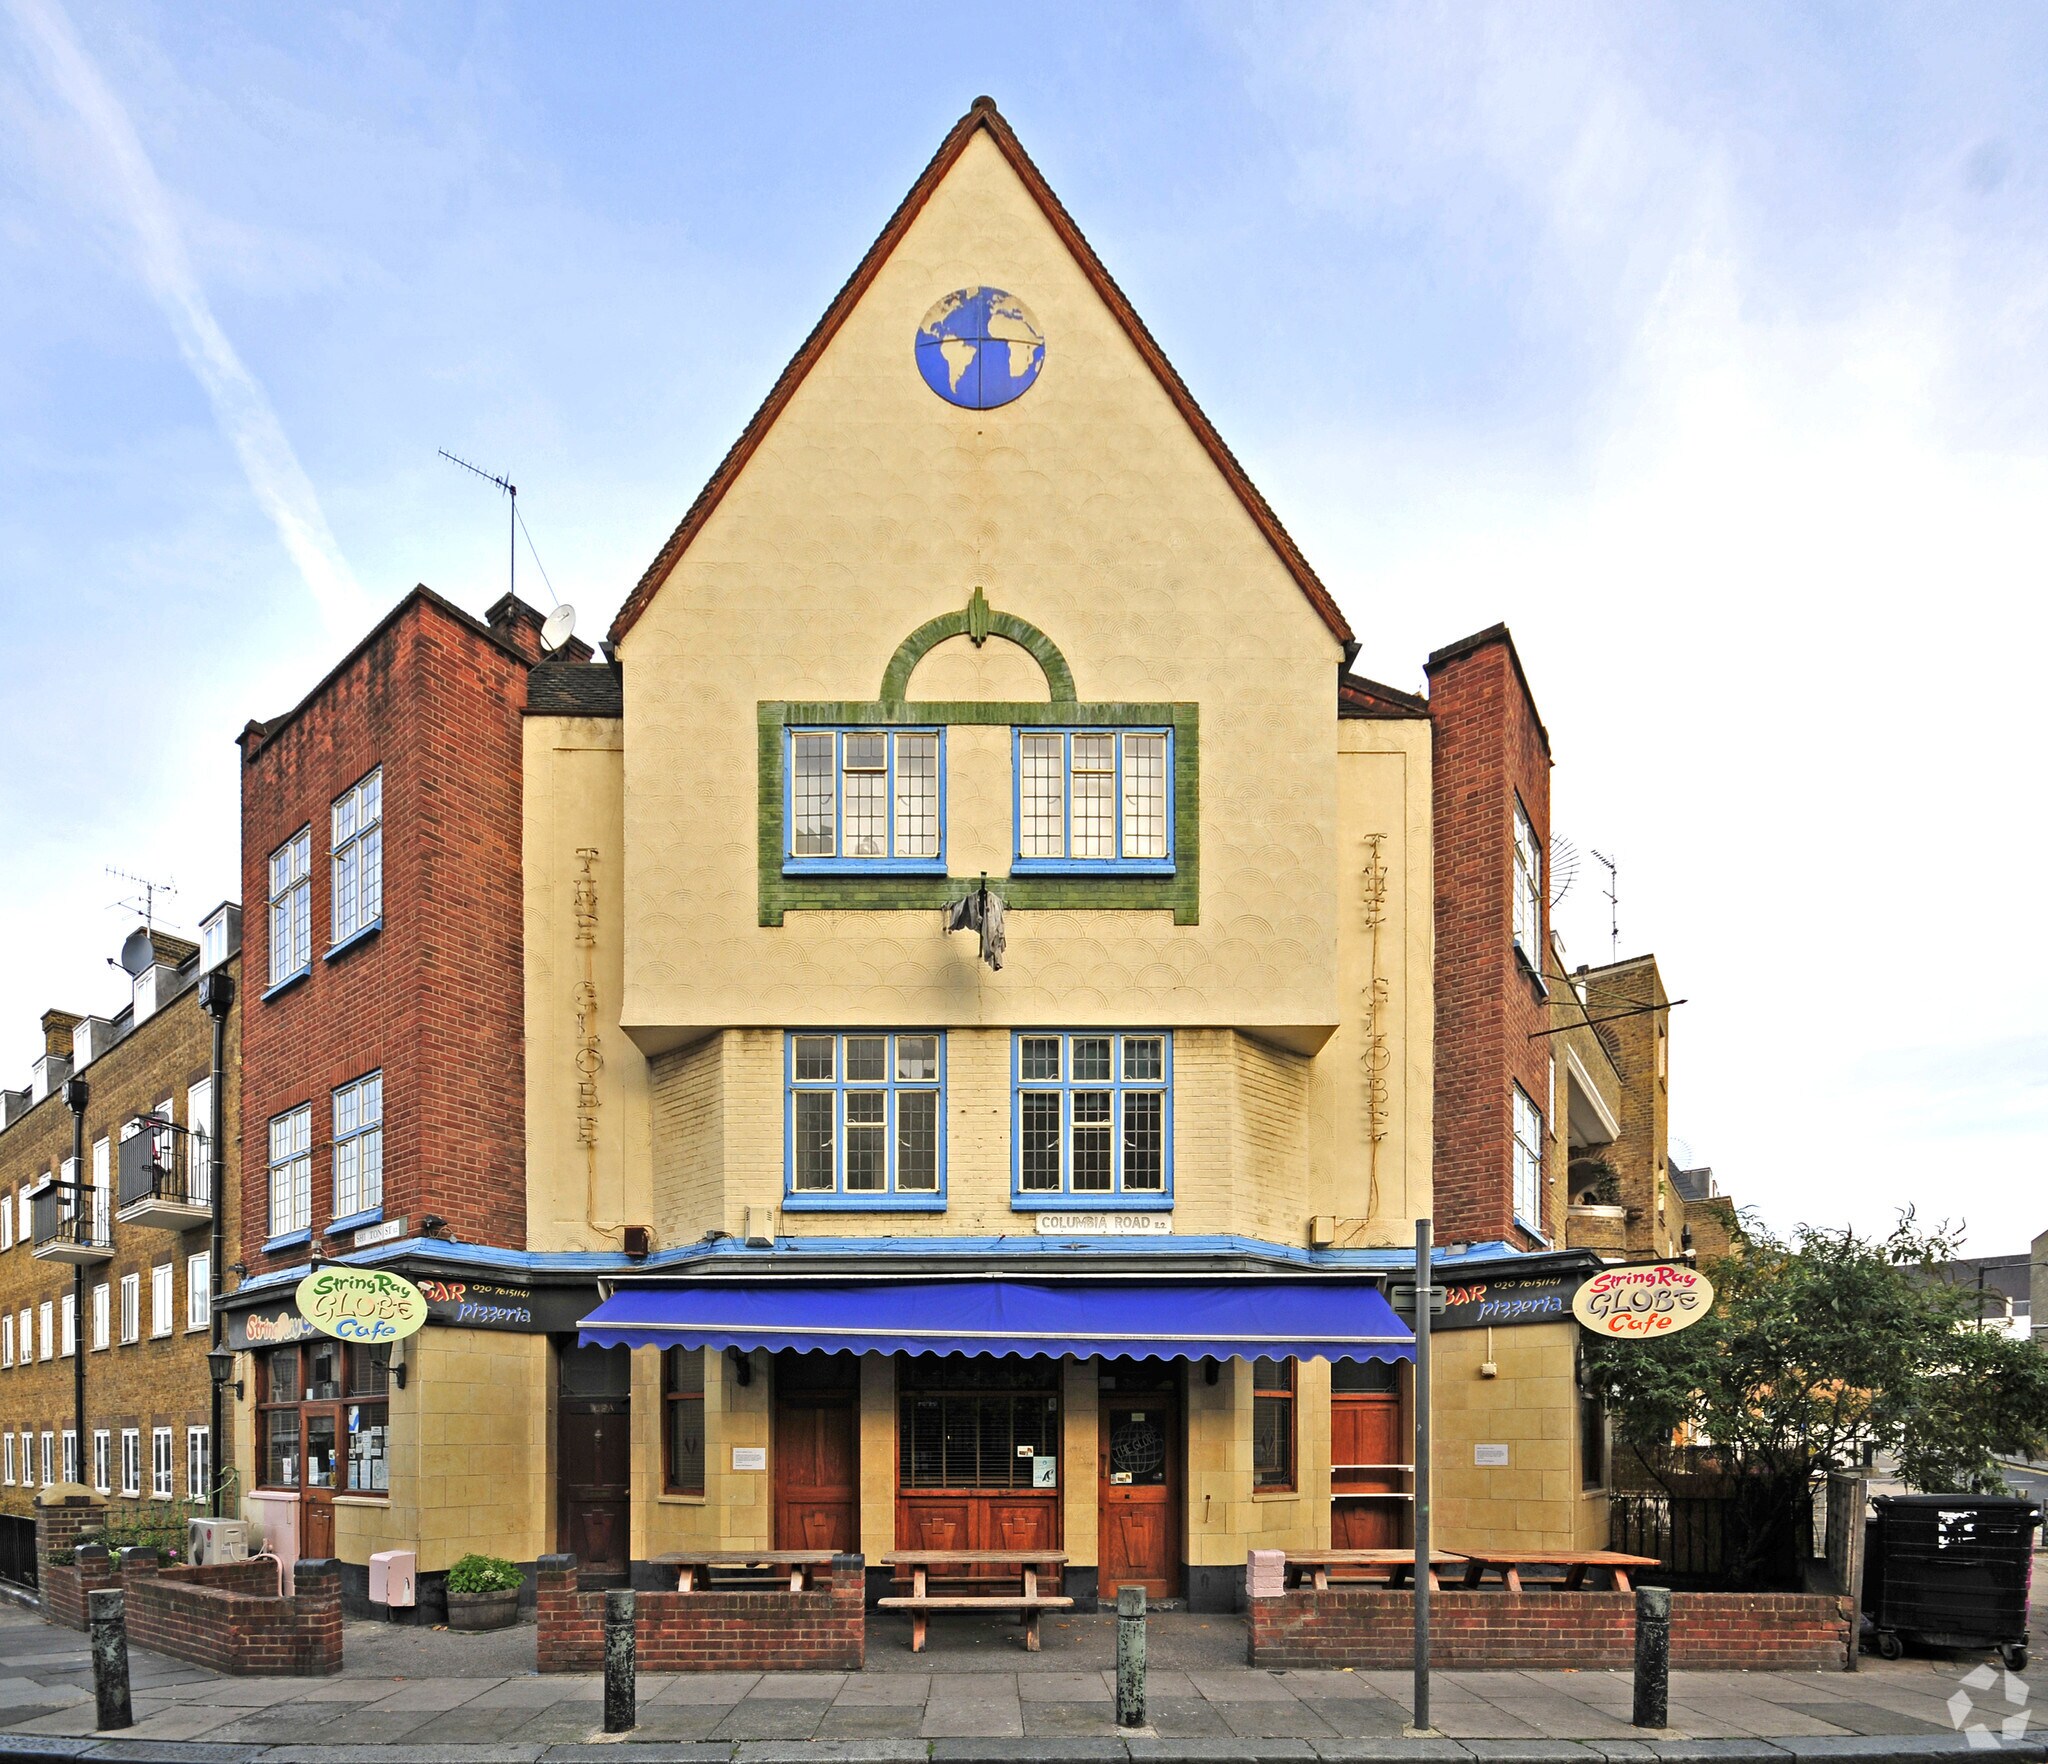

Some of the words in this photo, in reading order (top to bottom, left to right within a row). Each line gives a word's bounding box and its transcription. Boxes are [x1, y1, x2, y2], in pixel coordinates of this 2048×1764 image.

[1041, 1216, 1108, 1229] COLUMBIA
[1114, 1216, 1151, 1229] ROAD
[313, 1274, 411, 1299] StringRay
[472, 1284, 492, 1294] 020
[1494, 1281, 1516, 1290] 020
[1589, 1266, 1697, 1294] StringRay
[1445, 1284, 1488, 1306] BAR
[1586, 1288, 1700, 1321] GLOBE
[313, 1293, 414, 1323] GLOBE
[456, 1302, 532, 1323] pizzeria
[1477, 1295, 1563, 1321] pizzeria
[335, 1318, 397, 1341] Cafe
[1607, 1312, 1673, 1335] Cafe
